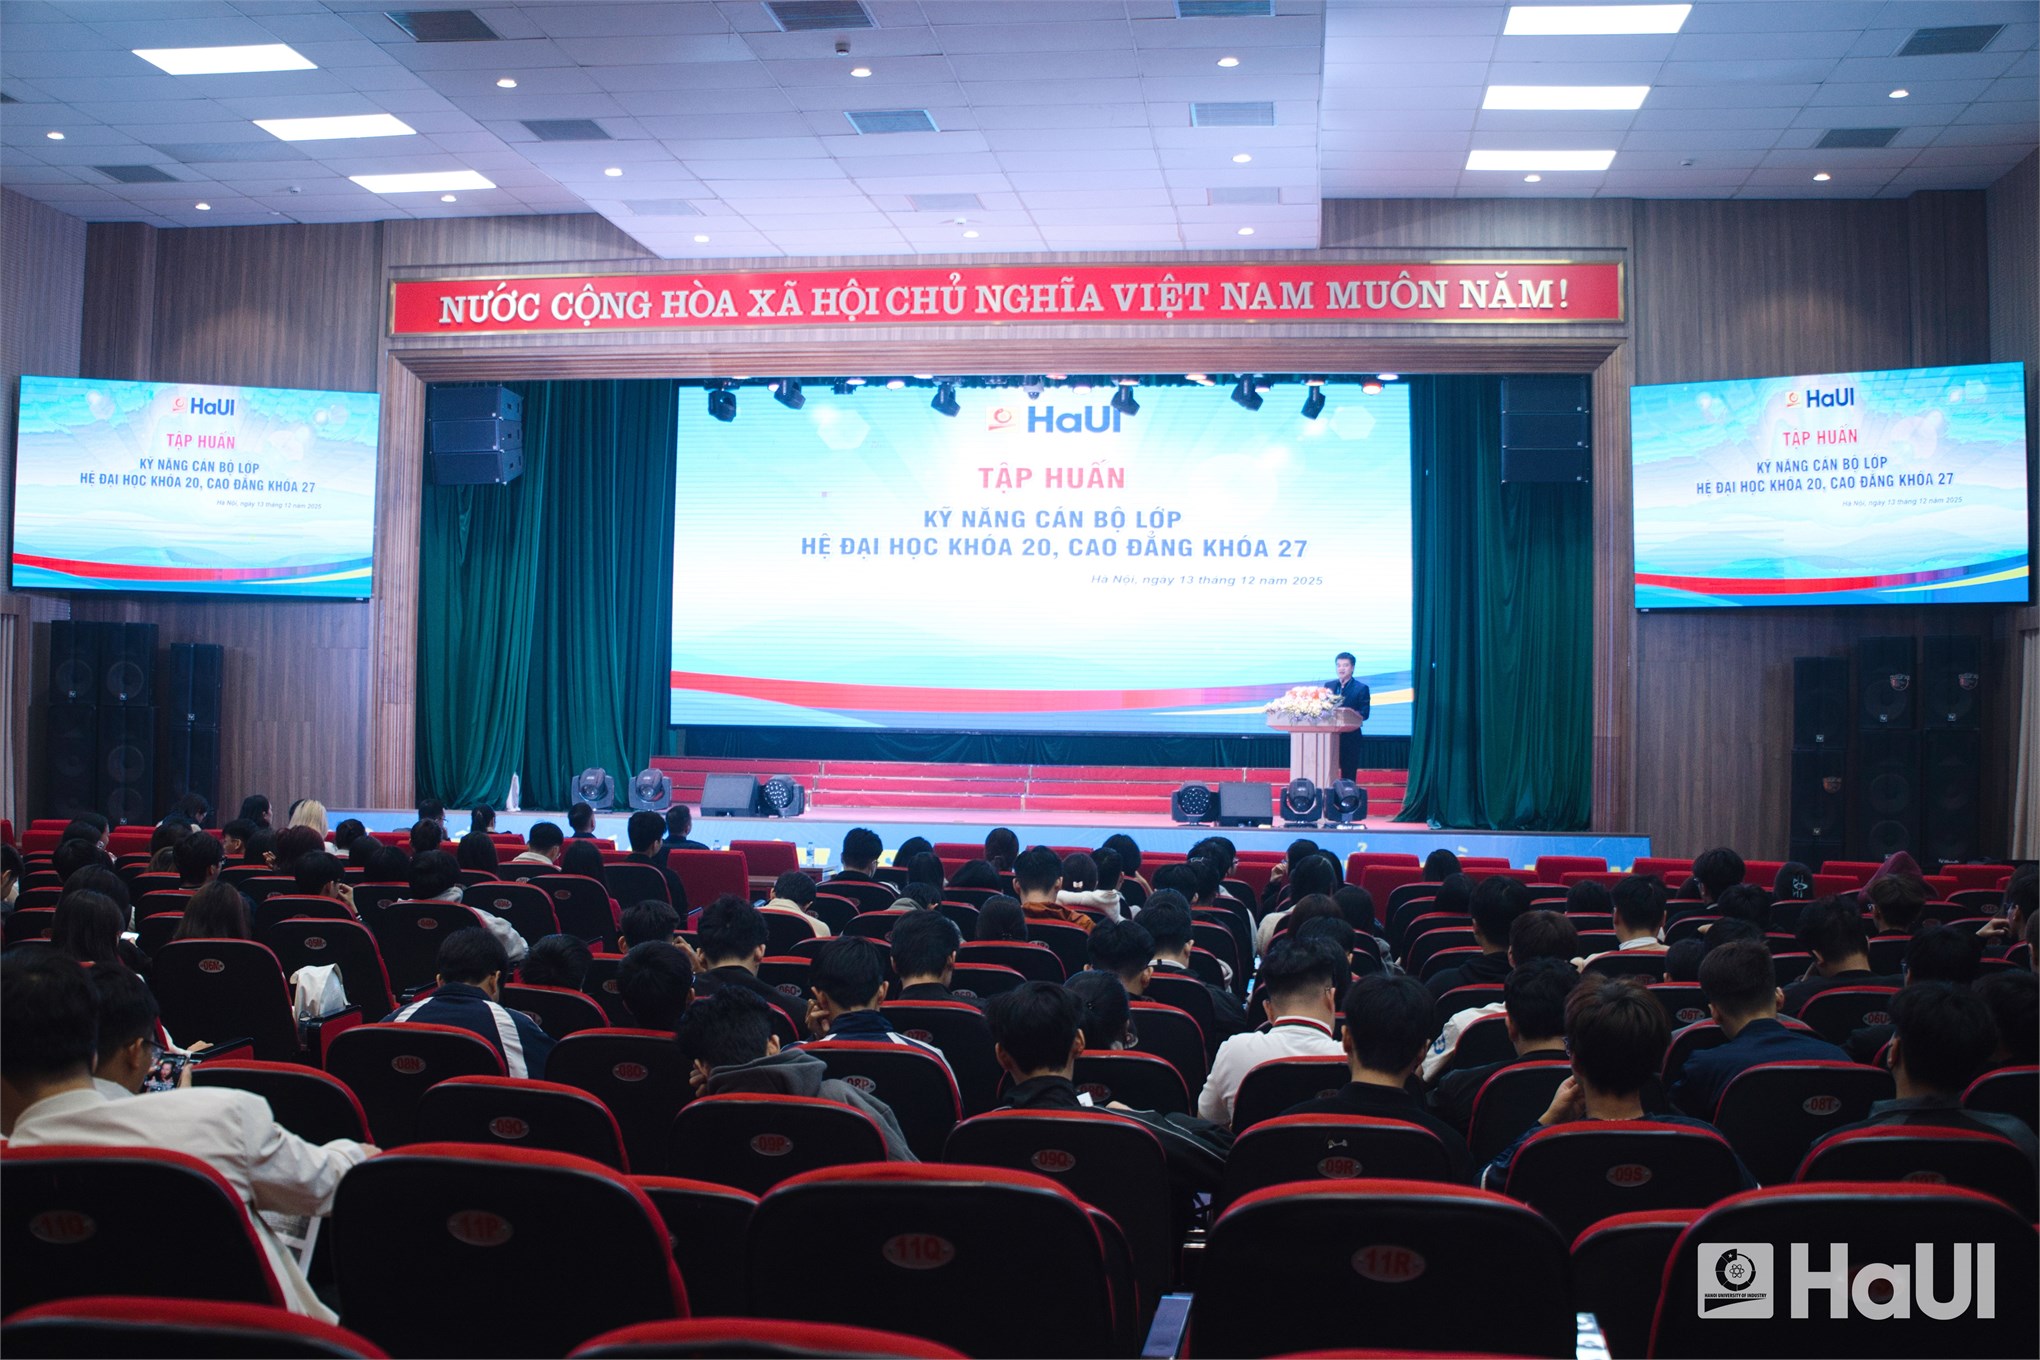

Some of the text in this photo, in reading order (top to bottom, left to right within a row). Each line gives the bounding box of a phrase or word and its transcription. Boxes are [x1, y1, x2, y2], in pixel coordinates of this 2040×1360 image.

[439, 270, 1570, 327] NƯỚC CỘNG HÒA XÃ HỘI CHỦ NGHĨA VIỆT NAM MUÔN NĂM!
[190, 398, 235, 416] HaUI
[1806, 387, 1855, 408] HaUI
[1027, 405, 1122, 433] HaUI
[167, 430, 236, 450] TẬP HUẤN
[1783, 424, 1859, 449] TẬP HUẤN
[122, 473, 147, 489] HỌC
[185, 476, 204, 491] 20,
[206, 477, 230, 491] CAO
[301, 480, 316, 494] 27
[978, 459, 1125, 494] TẬP HUẤN
[1740, 478, 1767, 494] HỌC
[1806, 475, 1828, 493] 20,
[1829, 474, 1857, 489] CAO
[1937, 472, 1954, 484] 27
[924, 506, 1183, 533] KỸ NĂNG CÁN BỘ LỚP
[801, 530, 1309, 561] HỆ ĐẠI HỌC KHÓA 20, CAO ĐẲNG KHÓA 27
[1179, 576, 1194, 585] 13
[1241, 576, 1255, 586] 12
[1292, 576, 1324, 586] 2025
[1681, 1009, 1700, 1020] 06T
[1810, 1097, 1834, 1110] 08T
[758, 1135, 785, 1151] 09P
[1325, 1159, 1354, 1175] 09R
[1615, 1167, 1643, 1181] 09S
[1365, 1248, 1410, 1275] 11R
